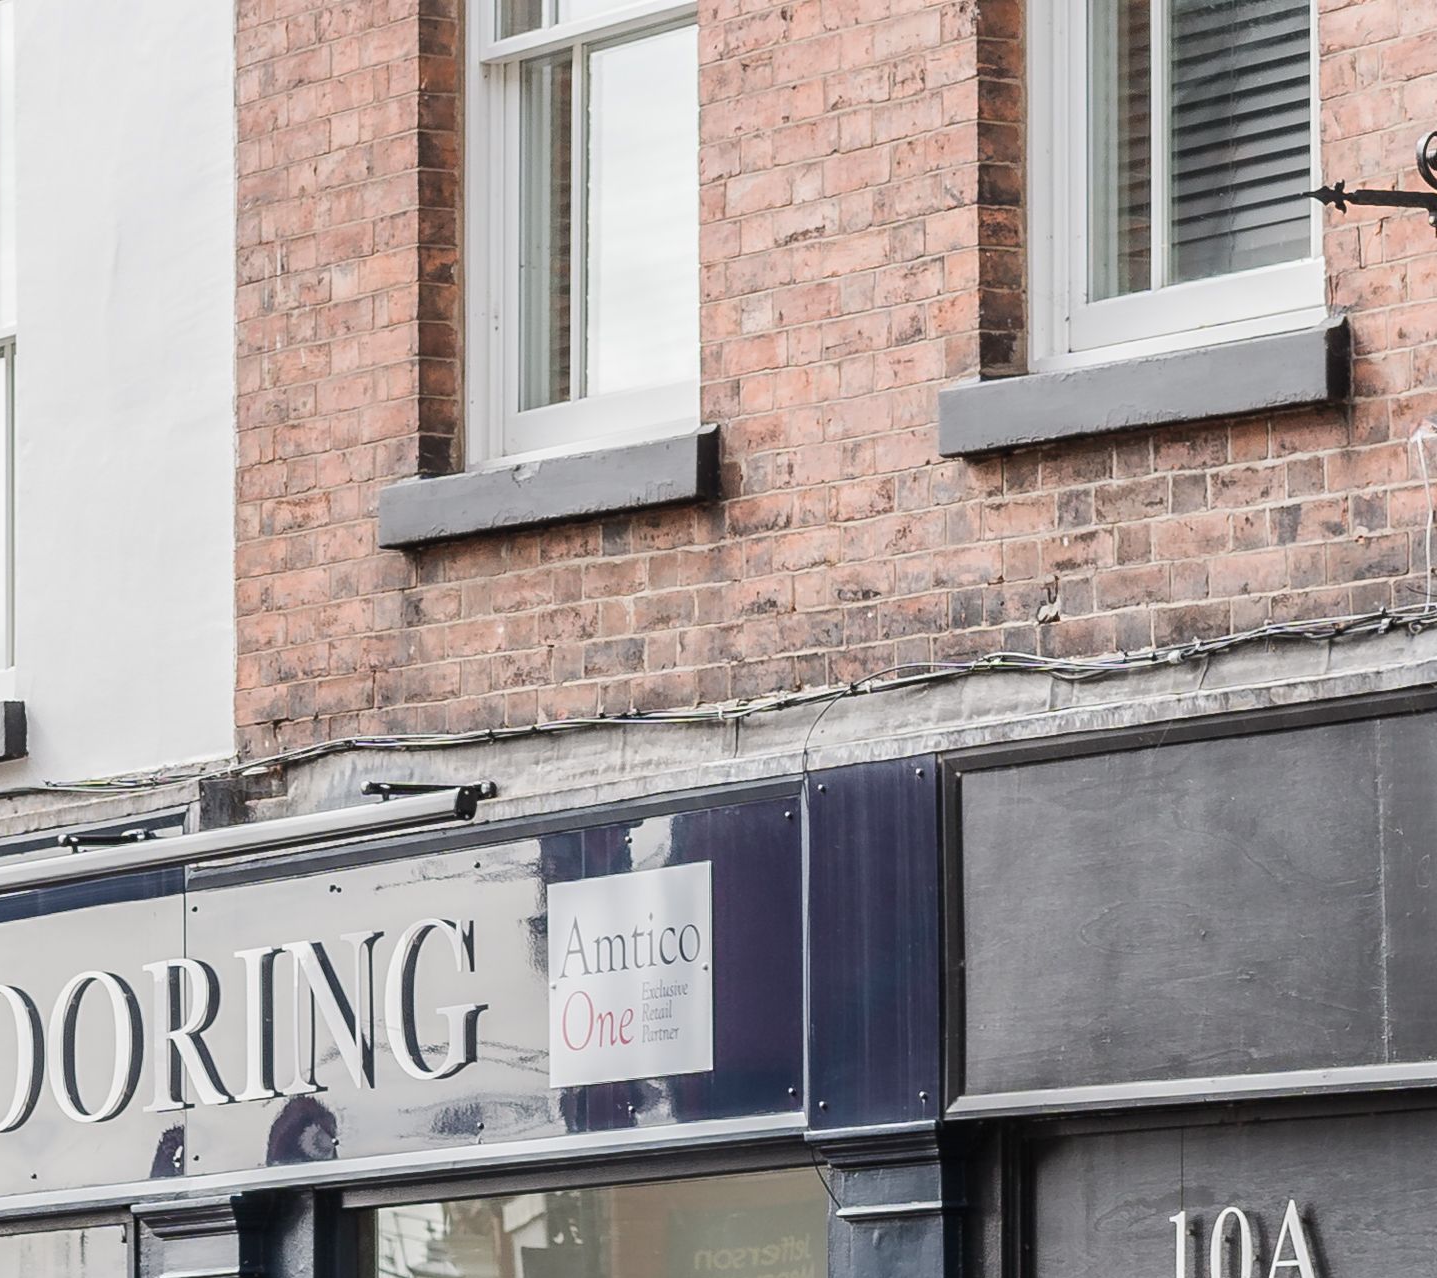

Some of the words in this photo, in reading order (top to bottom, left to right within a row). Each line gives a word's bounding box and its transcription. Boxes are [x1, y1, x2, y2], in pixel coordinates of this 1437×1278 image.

[559, 911, 701, 979] Amtico
[641, 978, 689, 1001] Exclusive
[562, 990, 634, 1051] One
[641, 1001, 672, 1022] Retail
[641, 1025, 680, 1044] Partner
